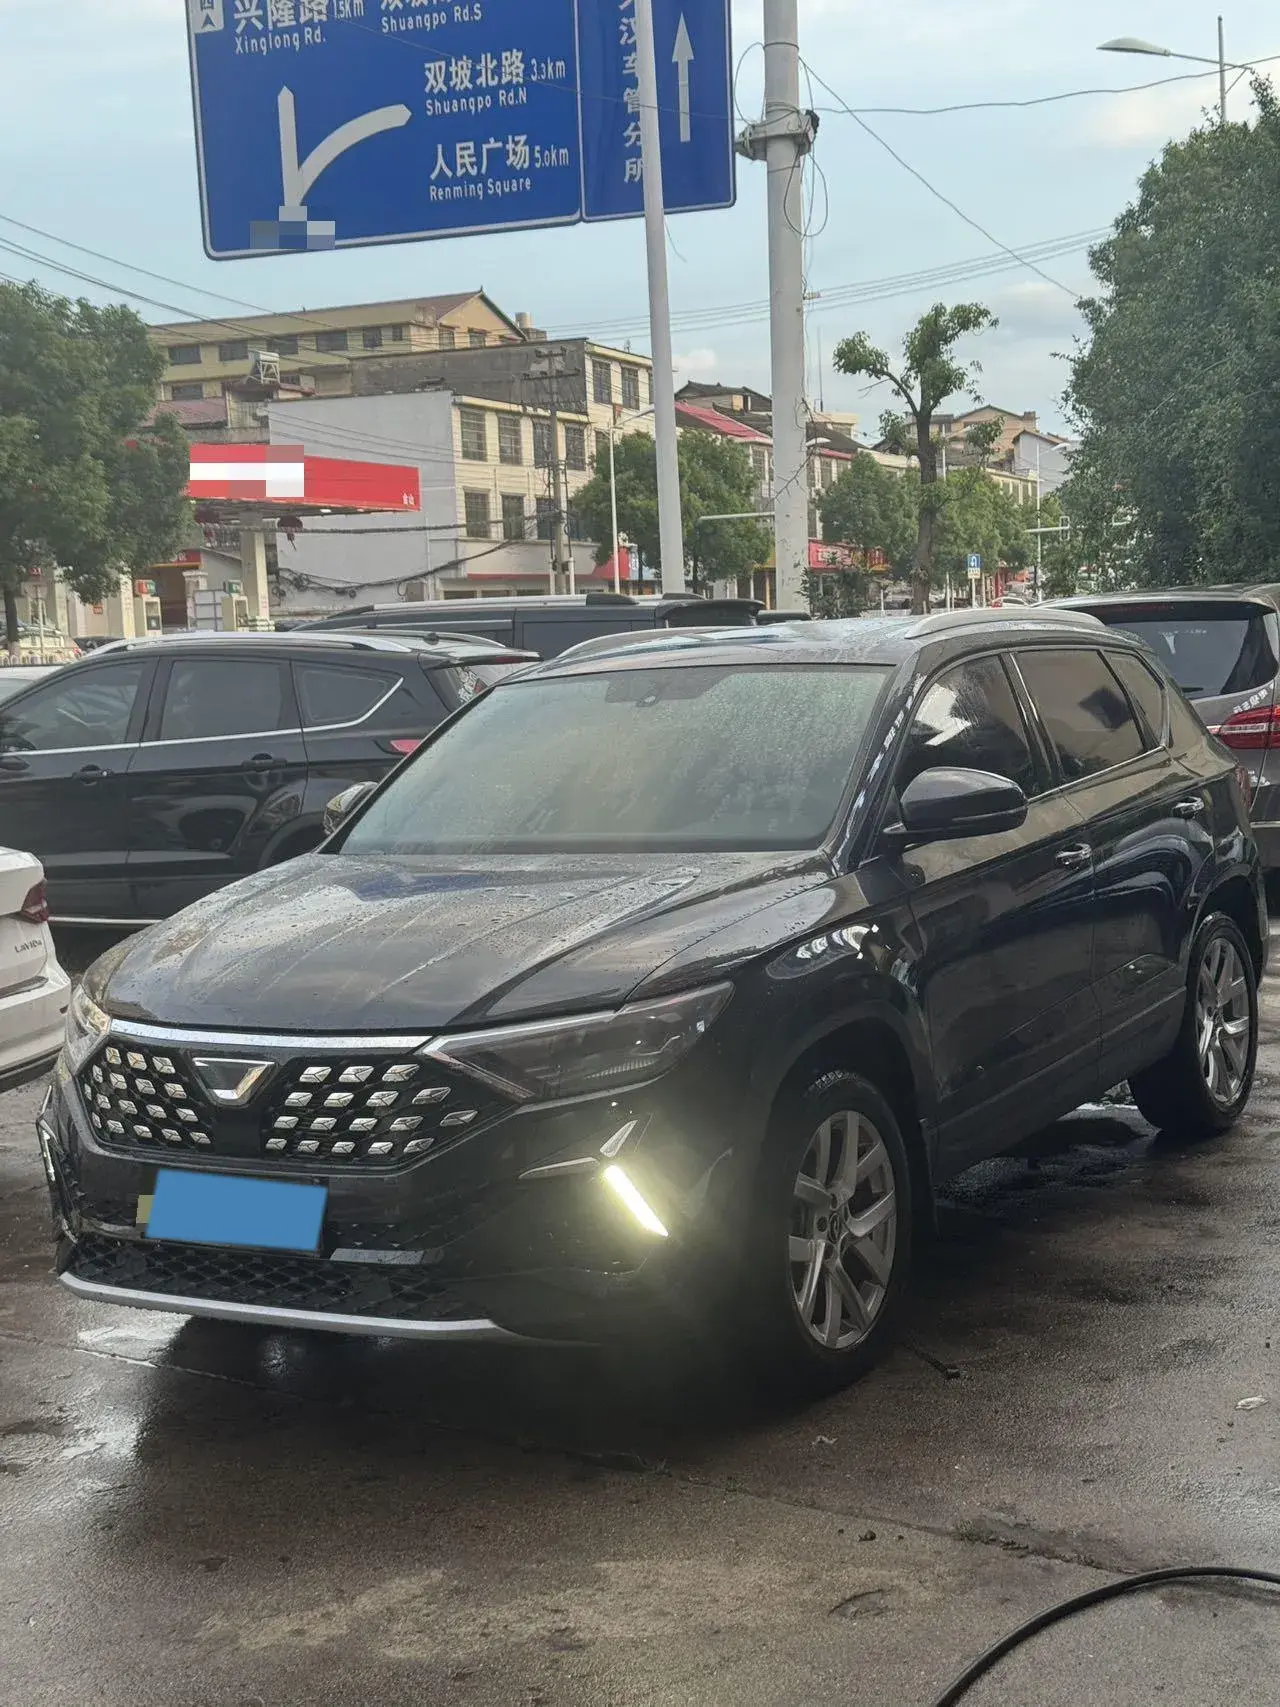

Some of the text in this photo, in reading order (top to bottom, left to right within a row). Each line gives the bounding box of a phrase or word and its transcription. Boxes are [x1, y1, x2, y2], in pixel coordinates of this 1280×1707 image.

[234, 0, 328, 34] 兴隆路
[381, 12, 447, 33] Shuangpo
[454, 3, 482, 22] Rd.S
[235, 26, 326, 56] Xinglong Rd.
[424, 48, 566, 94] 双坡北路 3.3km
[426, 87, 527, 116] Shuangpo Rd.N
[429, 134, 570, 180] 人民广场 5.0km
[429, 177, 532, 201] Renming Square
